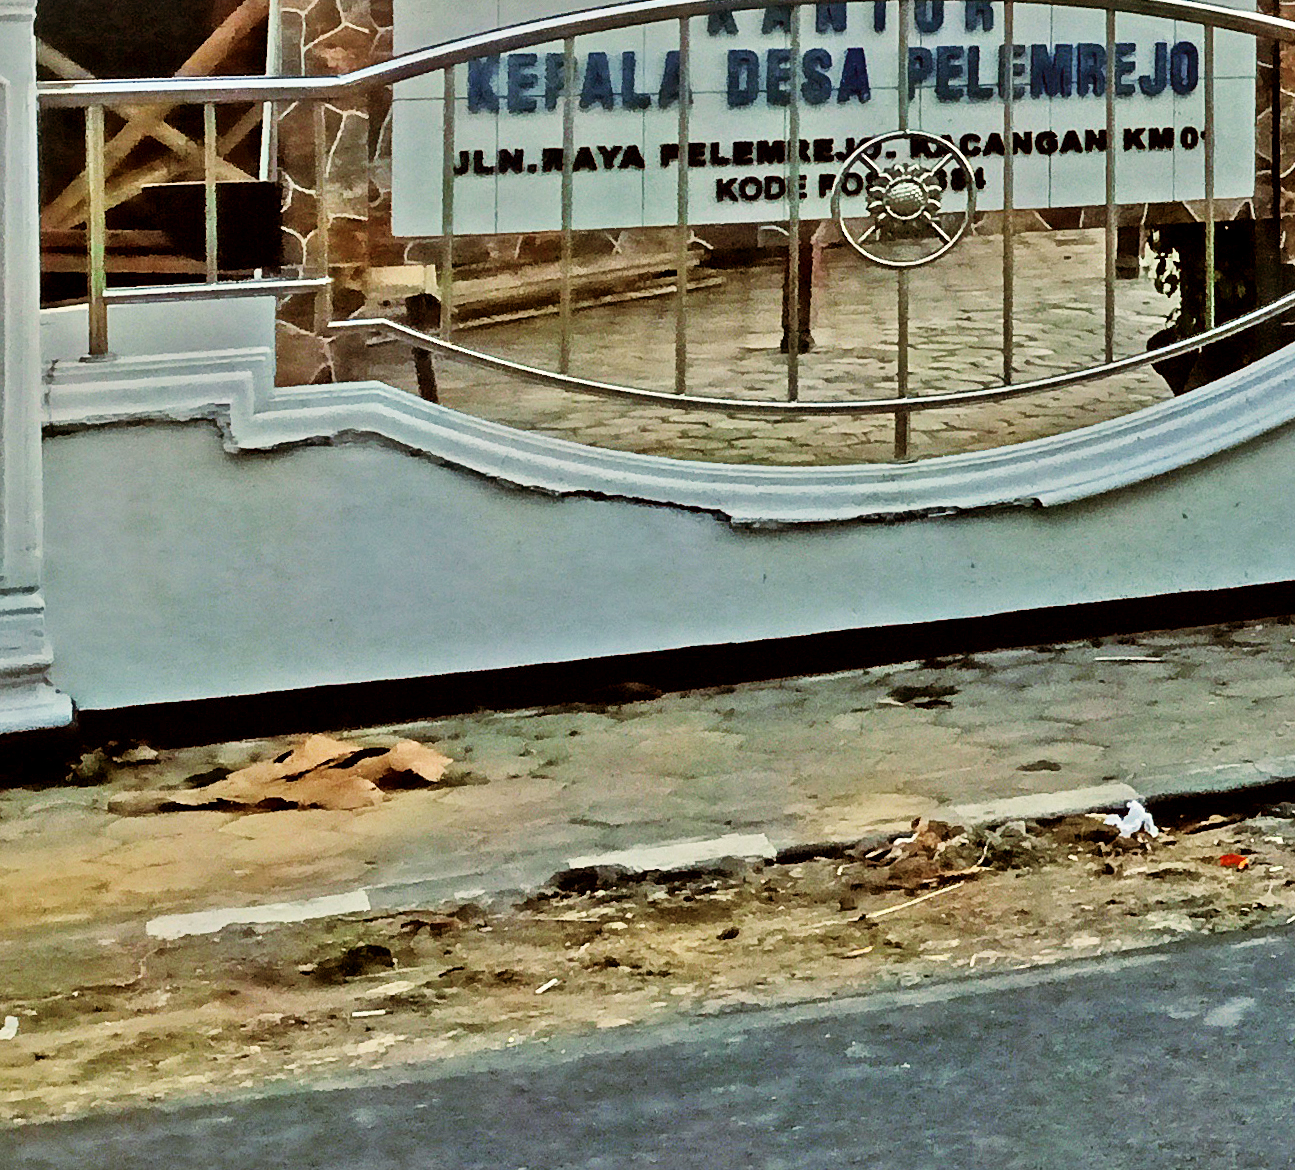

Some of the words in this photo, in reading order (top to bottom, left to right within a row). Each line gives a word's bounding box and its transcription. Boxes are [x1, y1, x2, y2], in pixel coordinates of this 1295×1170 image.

[467, 50, 694, 115] KEPALA
[726, 46, 872, 108] DESA
[904, 41, 1199, 103] PELEMREJO
[715, 173, 807, 203] KODE
